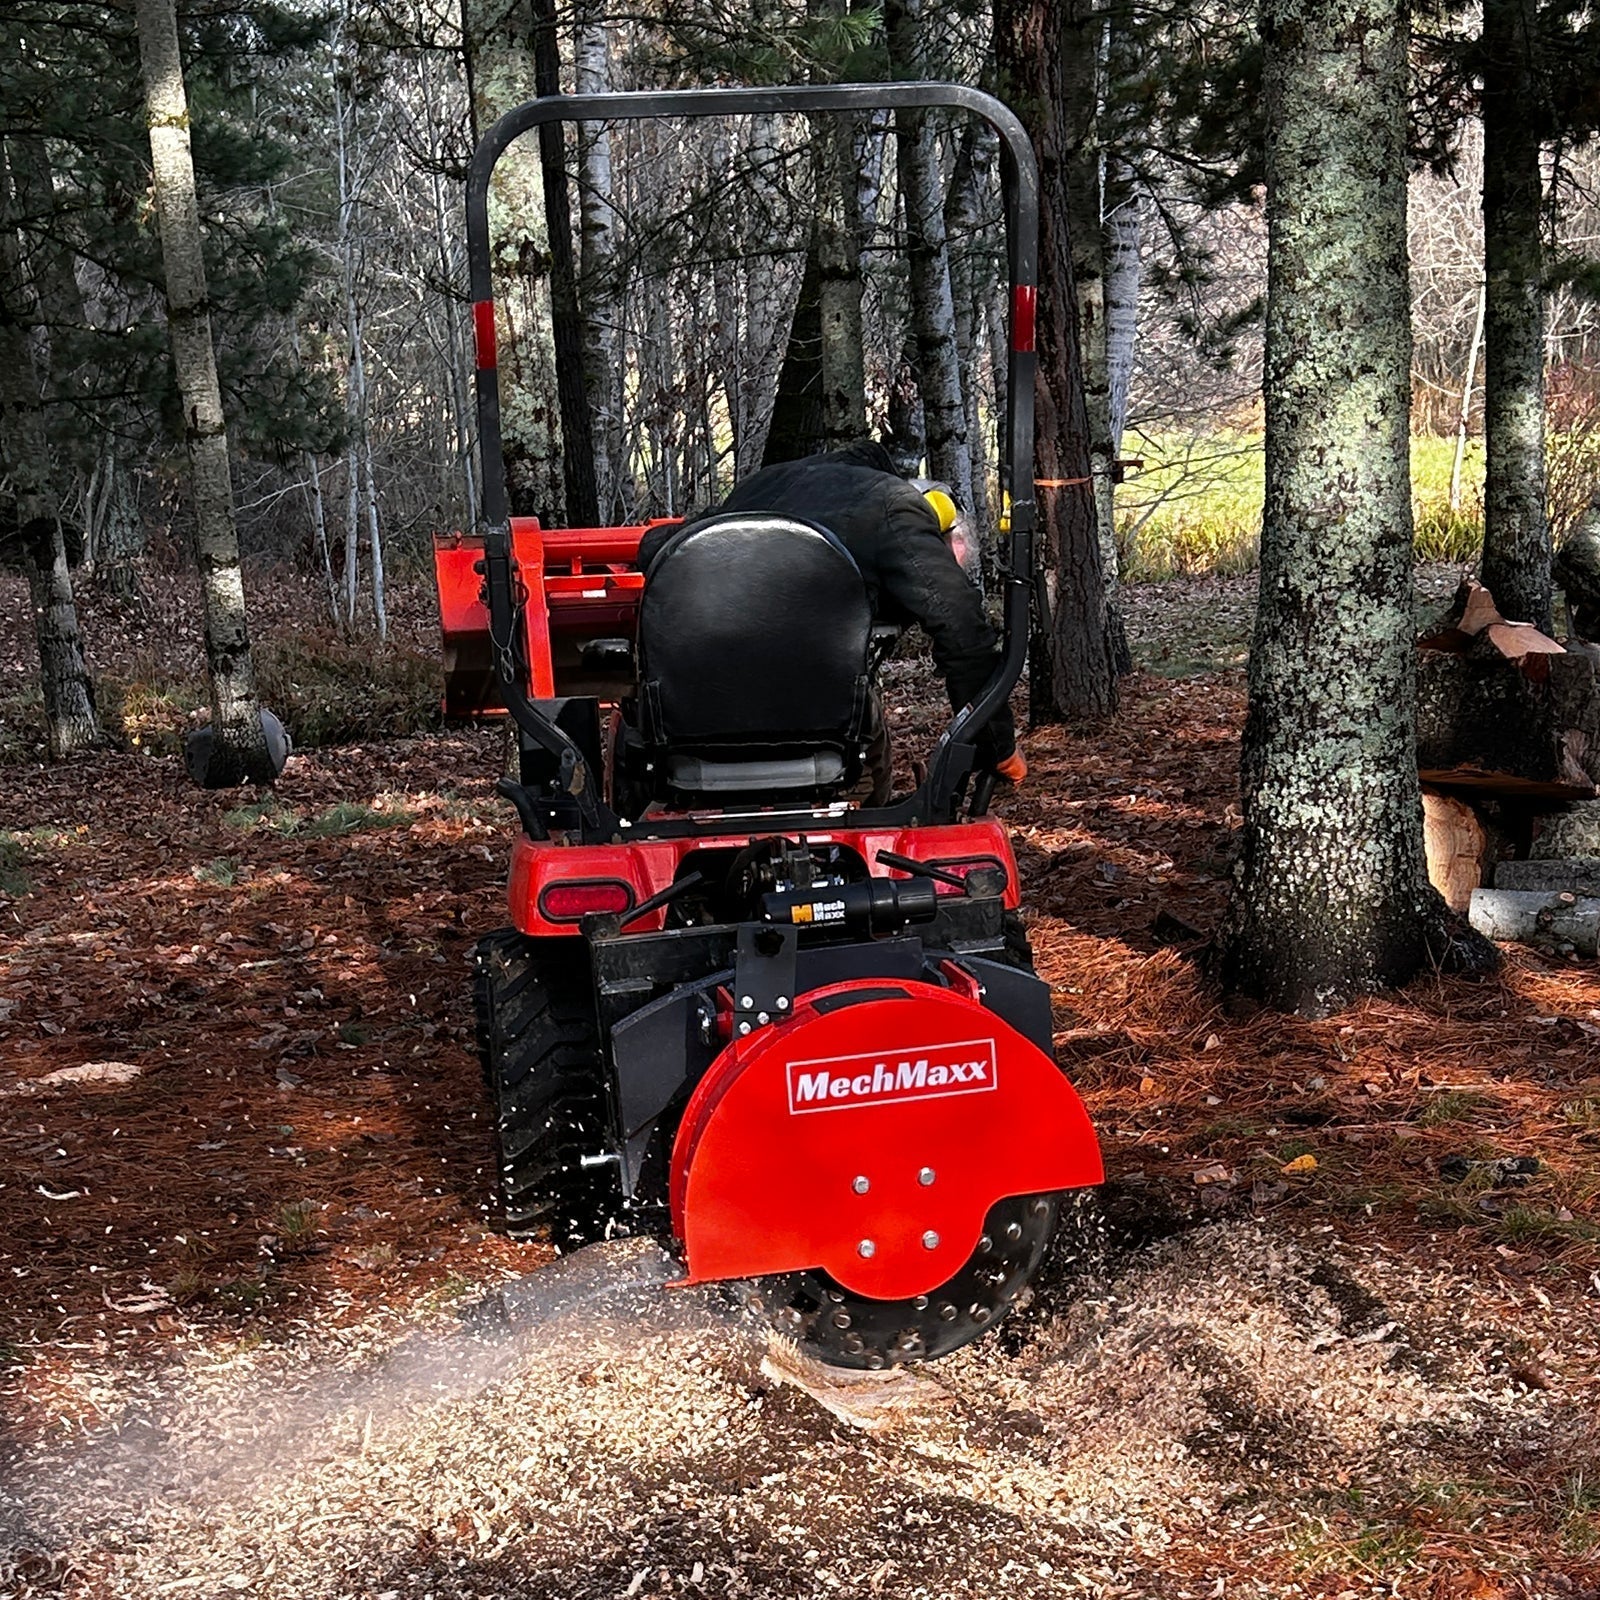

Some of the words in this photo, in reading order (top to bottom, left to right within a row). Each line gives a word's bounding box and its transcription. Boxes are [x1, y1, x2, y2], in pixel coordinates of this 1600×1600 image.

[812, 900, 845, 912] Mech
[813, 910, 845, 921] Maxx
[796, 1060, 988, 1102] MechMaxx
